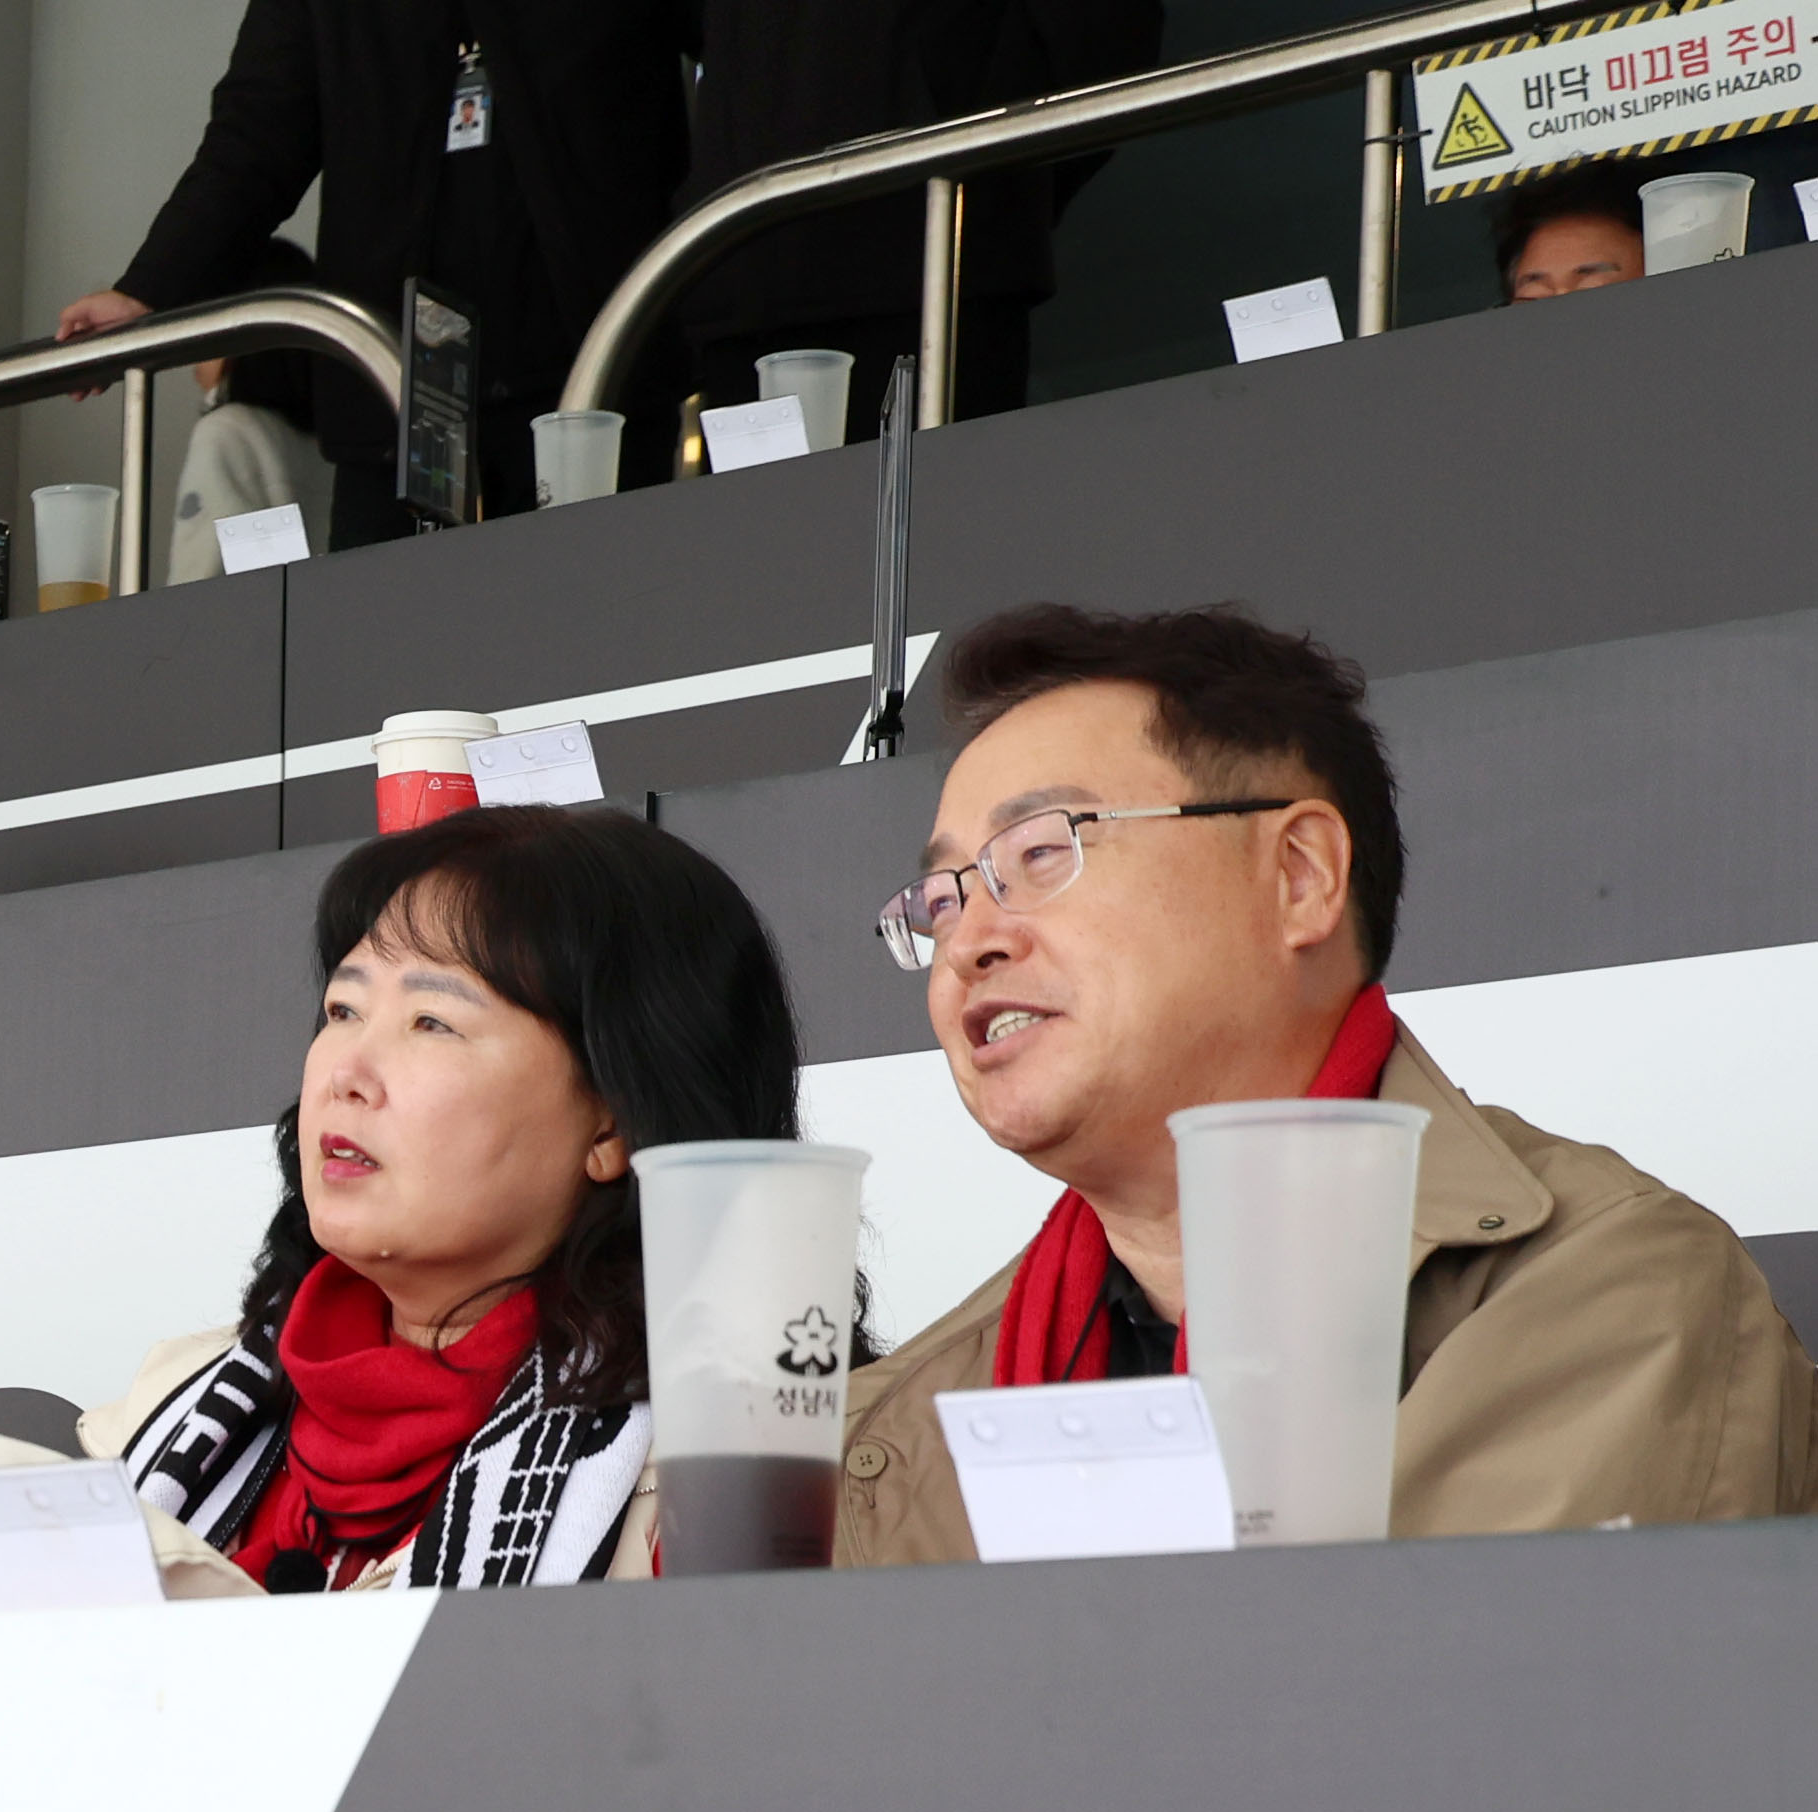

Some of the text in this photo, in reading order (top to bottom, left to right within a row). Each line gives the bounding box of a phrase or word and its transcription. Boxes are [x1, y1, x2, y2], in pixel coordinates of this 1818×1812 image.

[1523, 15, 1797, 110] 바닥 미끄럼 주의
[1527, 62, 1802, 140] CAUTION SLIPPING HAZARD
[773, 1386, 837, 1420] 성남시
